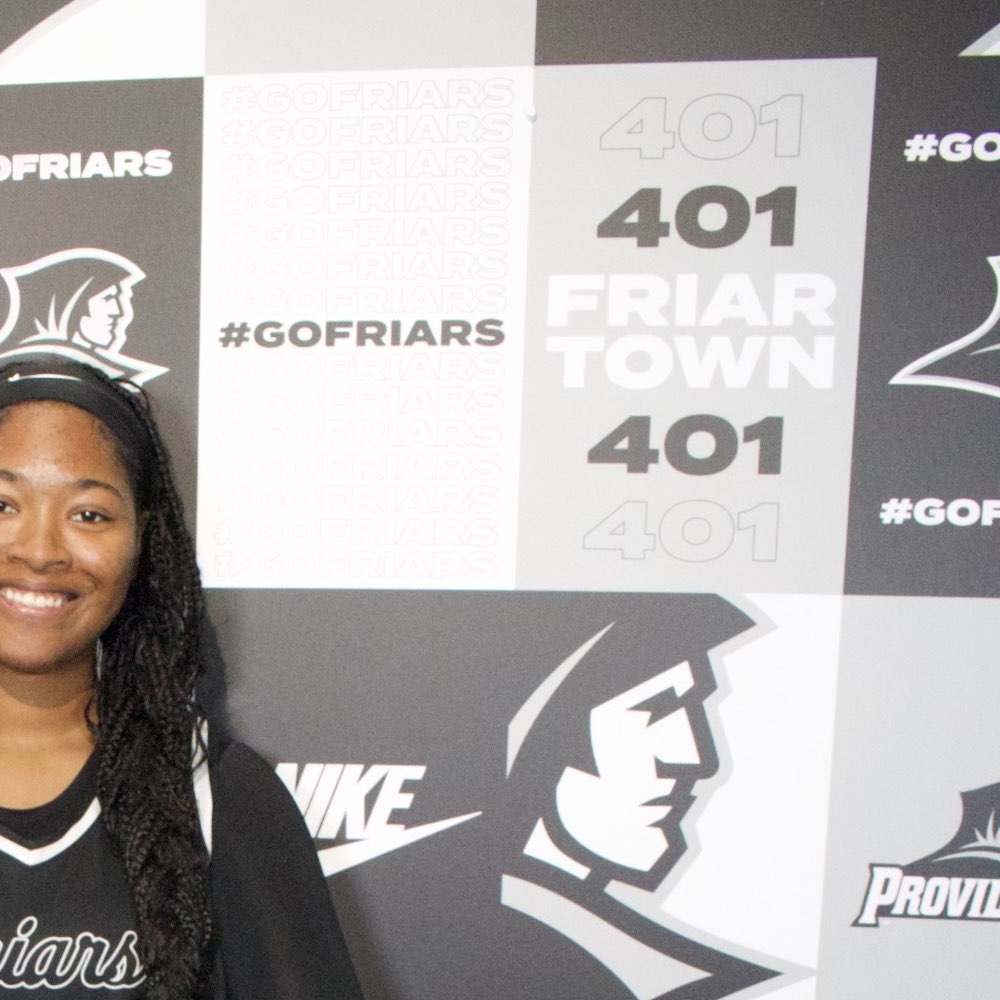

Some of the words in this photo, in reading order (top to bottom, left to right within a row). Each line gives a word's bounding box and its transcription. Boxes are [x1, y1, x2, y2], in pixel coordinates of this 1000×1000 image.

[221, 77, 515, 115] #GOFRIARS
[220, 112, 514, 149] #GOFRIARS
[600, 93, 804, 161] 401
[904, 131, 1000, 163] #GO
[220, 146, 512, 182] #GOFRIARS
[596, 184, 798, 249] 401
[546, 272, 837, 328] FRIAR
[219, 319, 505, 348] #GOFRIARS
[545, 334, 836, 390] TOWN
[587, 413, 785, 476] 401
[582, 499, 780, 563] 401
